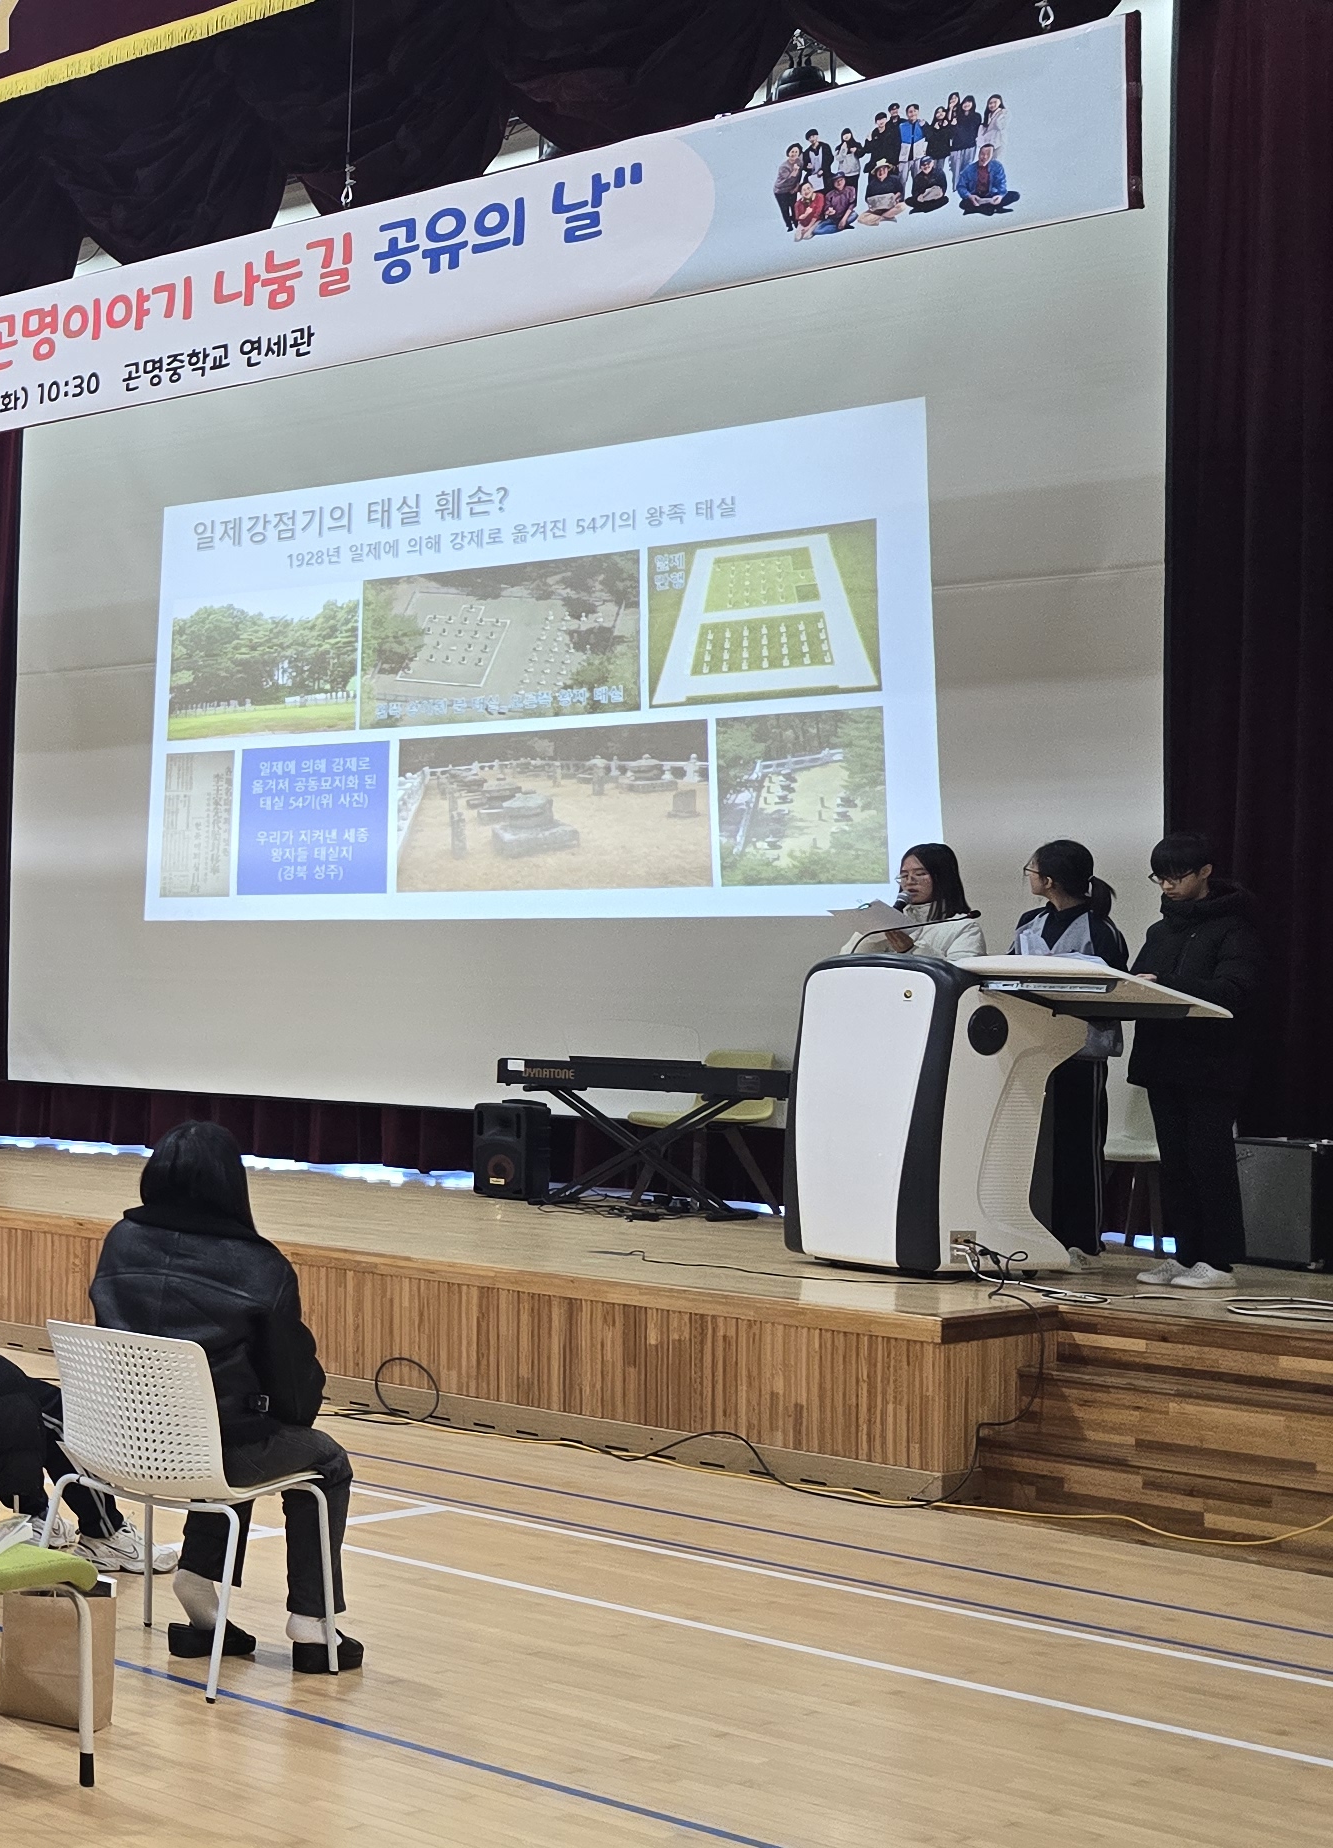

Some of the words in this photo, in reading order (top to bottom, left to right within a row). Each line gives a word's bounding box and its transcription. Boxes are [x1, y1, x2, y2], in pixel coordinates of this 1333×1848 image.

[213, 232, 353, 311] 나눔길
[373, 196, 525, 285] 공유의
[550, 161, 644, 243] 날"
[36, 371, 101, 406] 10:30
[122, 343, 231, 392] 곤명중학교
[239, 325, 315, 368] 연세관
[193, 502, 353, 551] 일제강점기의
[366, 493, 422, 530] 태실
[434, 485, 510, 521] 훼손?
[286, 545, 342, 569] 1928년
[348, 538, 400, 563] 일제에
[407, 533, 442, 556] 의해
[449, 527, 504, 551] 강제로
[511, 517, 566, 545] 옮겨진
[575, 508, 636, 535] 54기의
[644, 502, 686, 527] 왕족
[695, 495, 737, 521] 태실
[259, 759, 296, 776] 일제에
[301, 758, 327, 774] 의해
[331, 757, 371, 773] 강제로
[252, 777, 290, 795] 옮겨져
[293, 774, 359, 793] 공동묘지화
[364, 774, 377, 790] 된
[259, 795, 285, 811] 태실
[288, 793, 333, 810] 54기(위
[337, 792, 369, 809] 사진)
[256, 829, 294, 846] 우리가
[298, 828, 338, 845] 지켜낸
[343, 827, 370, 844] 세종
[271, 847, 309, 863] 왕자들
[314, 845, 353, 862] 태실지
[277, 865, 309, 882] (경북
[313, 864, 344, 881] 성주)
[522, 1067, 575, 1080] DYNATONE
